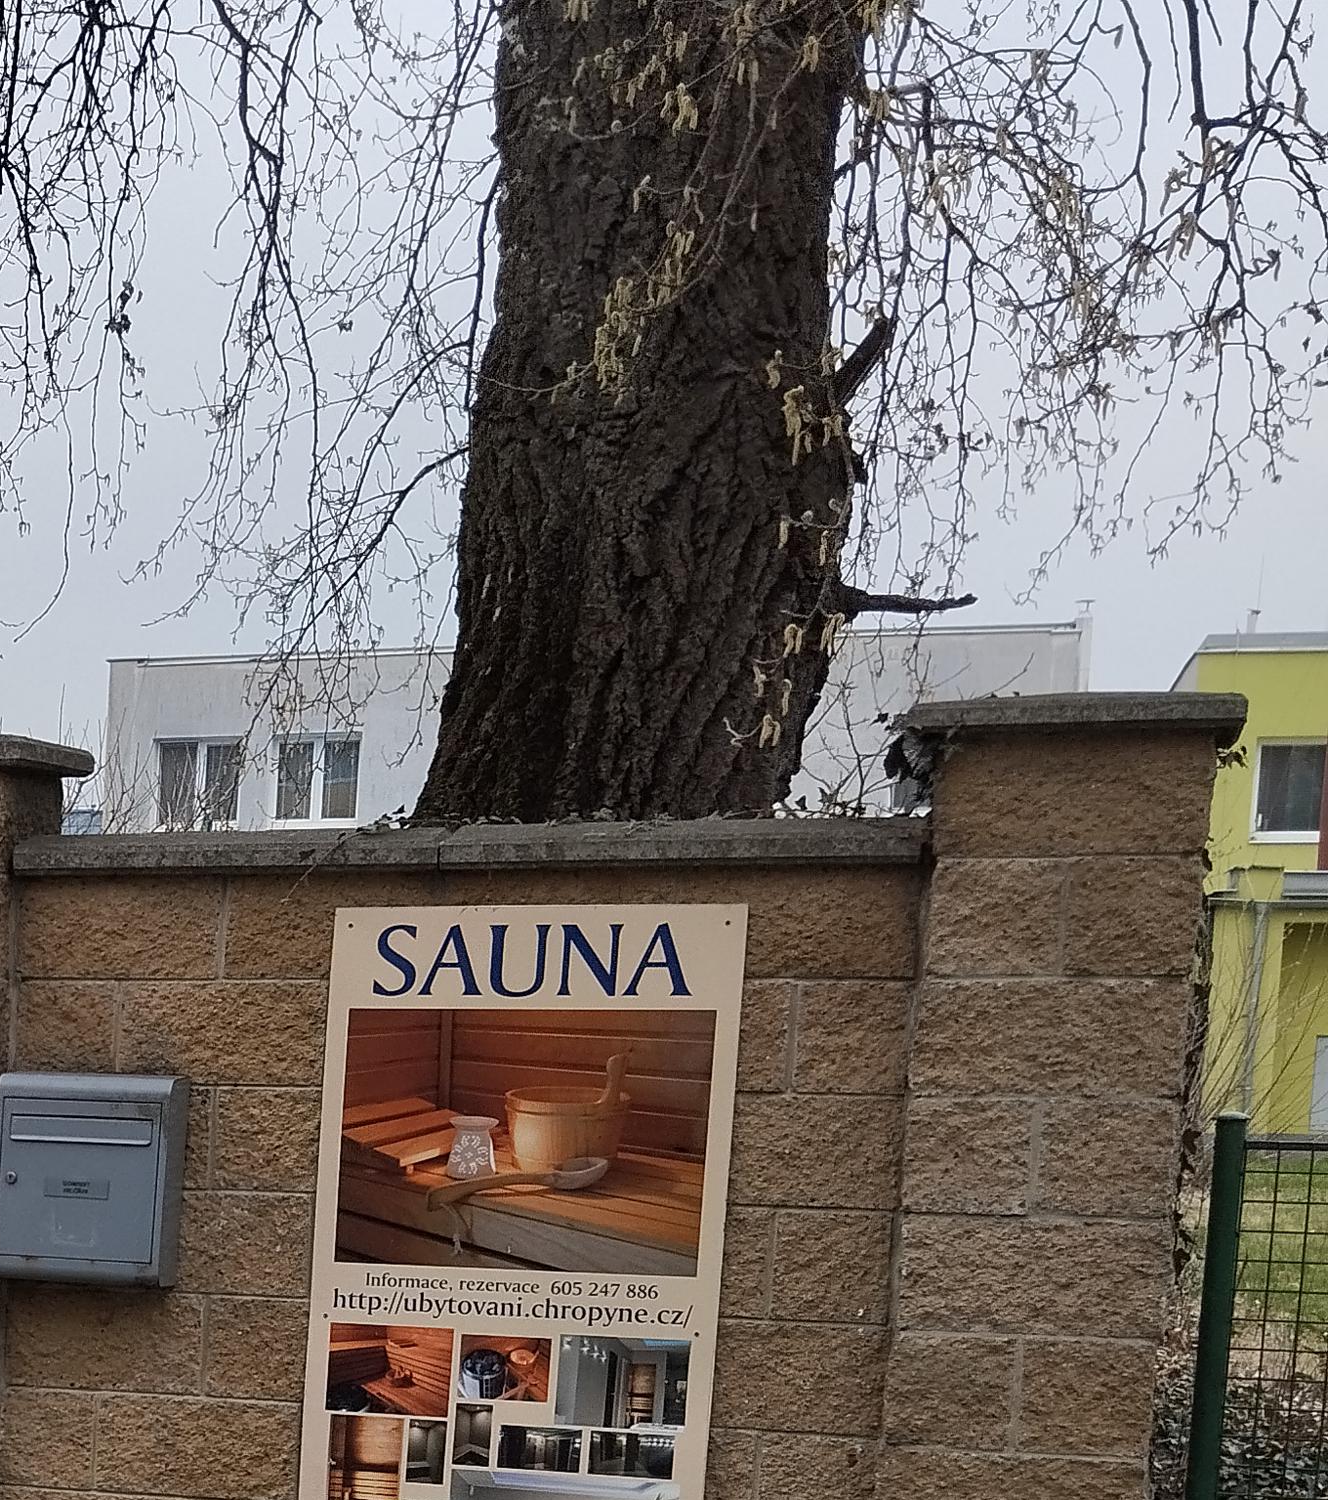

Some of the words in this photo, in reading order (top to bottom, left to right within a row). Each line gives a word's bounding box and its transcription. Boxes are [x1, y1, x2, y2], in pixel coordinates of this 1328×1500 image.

[372, 922, 693, 998] SAUNA
[365, 1271, 453, 1292] Informace,
[459, 1278, 540, 1295] rezervace
[550, 1280, 582, 1297] 605
[588, 1281, 621, 1298] 247
[625, 1283, 660, 1300] 886
[332, 1288, 694, 1329] http://ubytovani.chropyne.cz/
